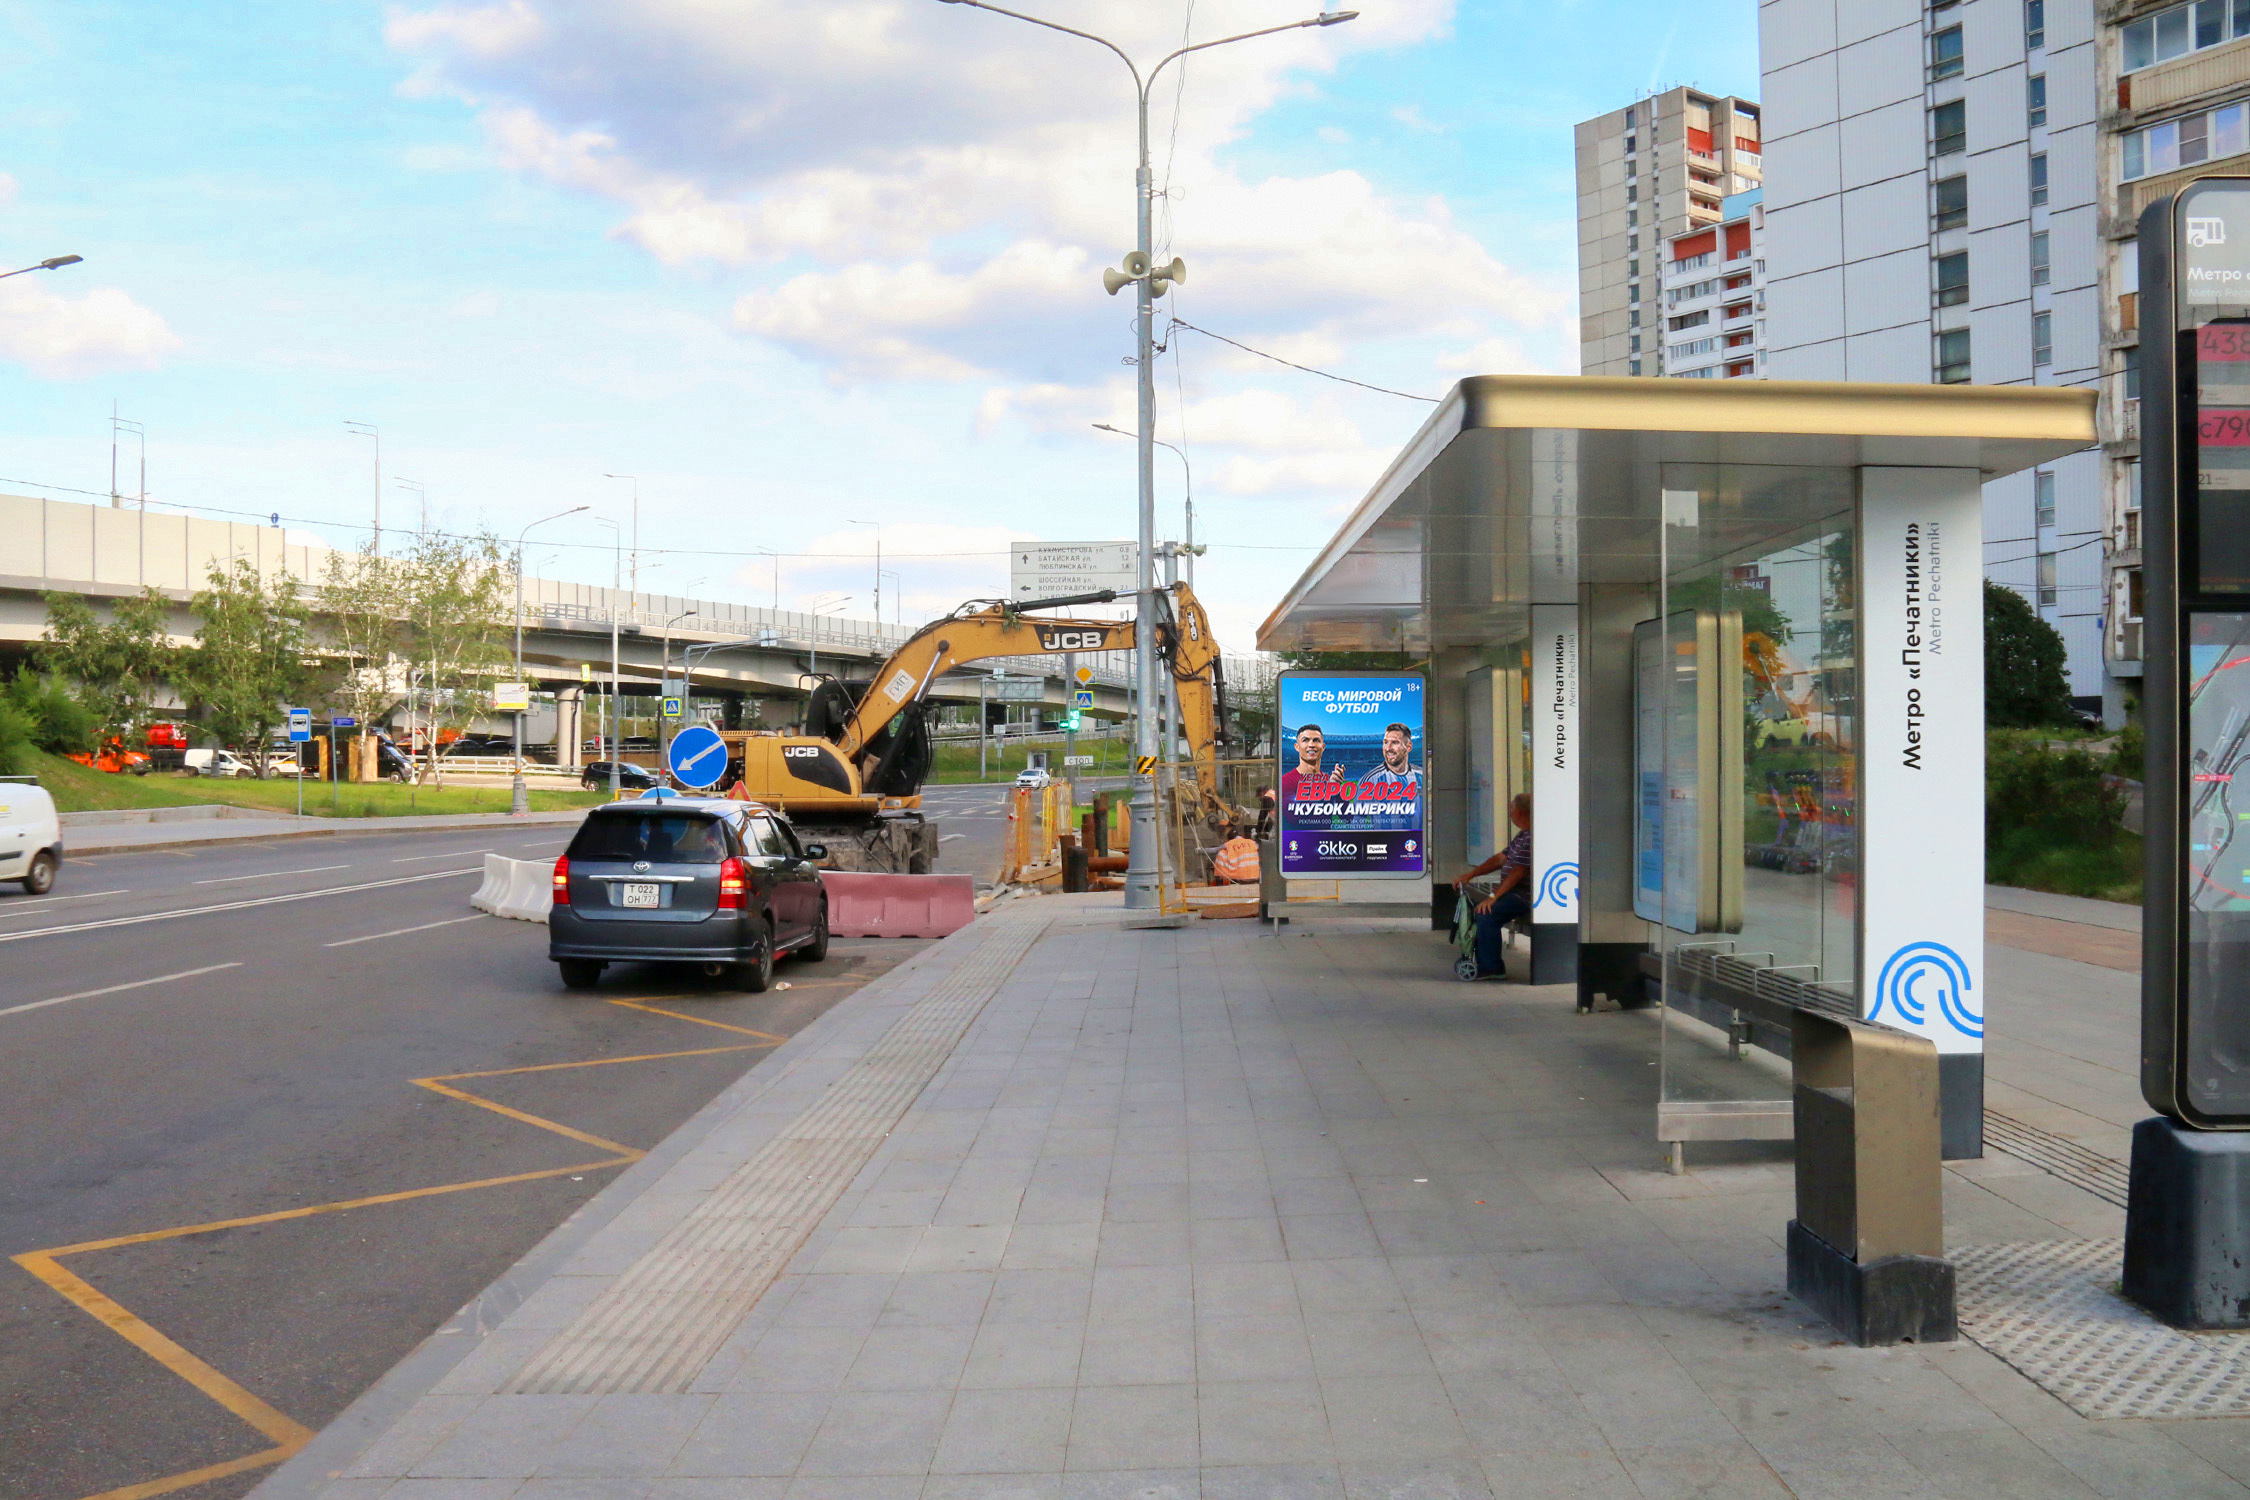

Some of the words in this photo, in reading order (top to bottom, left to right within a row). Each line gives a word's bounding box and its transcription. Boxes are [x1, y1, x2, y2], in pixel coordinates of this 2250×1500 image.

[2187, 267, 2242, 283] Метро
[2198, 473, 2213, 485] 21
[1927, 522, 1940, 601] Pechatniki
[1902, 522, 1921, 680] «Печатники»
[1928, 607, 1941, 655] Metro
[1044, 632, 1102, 649] JCB
[1553, 634, 1565, 720] «Печатники»
[1302, 690, 1335, 702] ВЕСЬ
[1337, 687, 1402, 702] МИРОВОЙ
[1406, 683, 1420, 692] 18+
[1325, 703, 1379, 714] ФУТБОЛ
[1903, 688, 1925, 770] Метро
[785, 747, 819, 757] JCB
[1554, 724, 1567, 769] Метро
[1068, 757, 1090, 765] СТОП
[1300, 773, 1329, 781] УЕФА
[1295, 781, 1357, 801] ЕВРО
[1358, 781, 1417, 801] 2024
[1294, 803, 1344, 816] КУБОК
[1344, 803, 1416, 815] АМЕРИКИ
[1318, 840, 1357, 855] okko
[637, 885, 654, 893] 022
